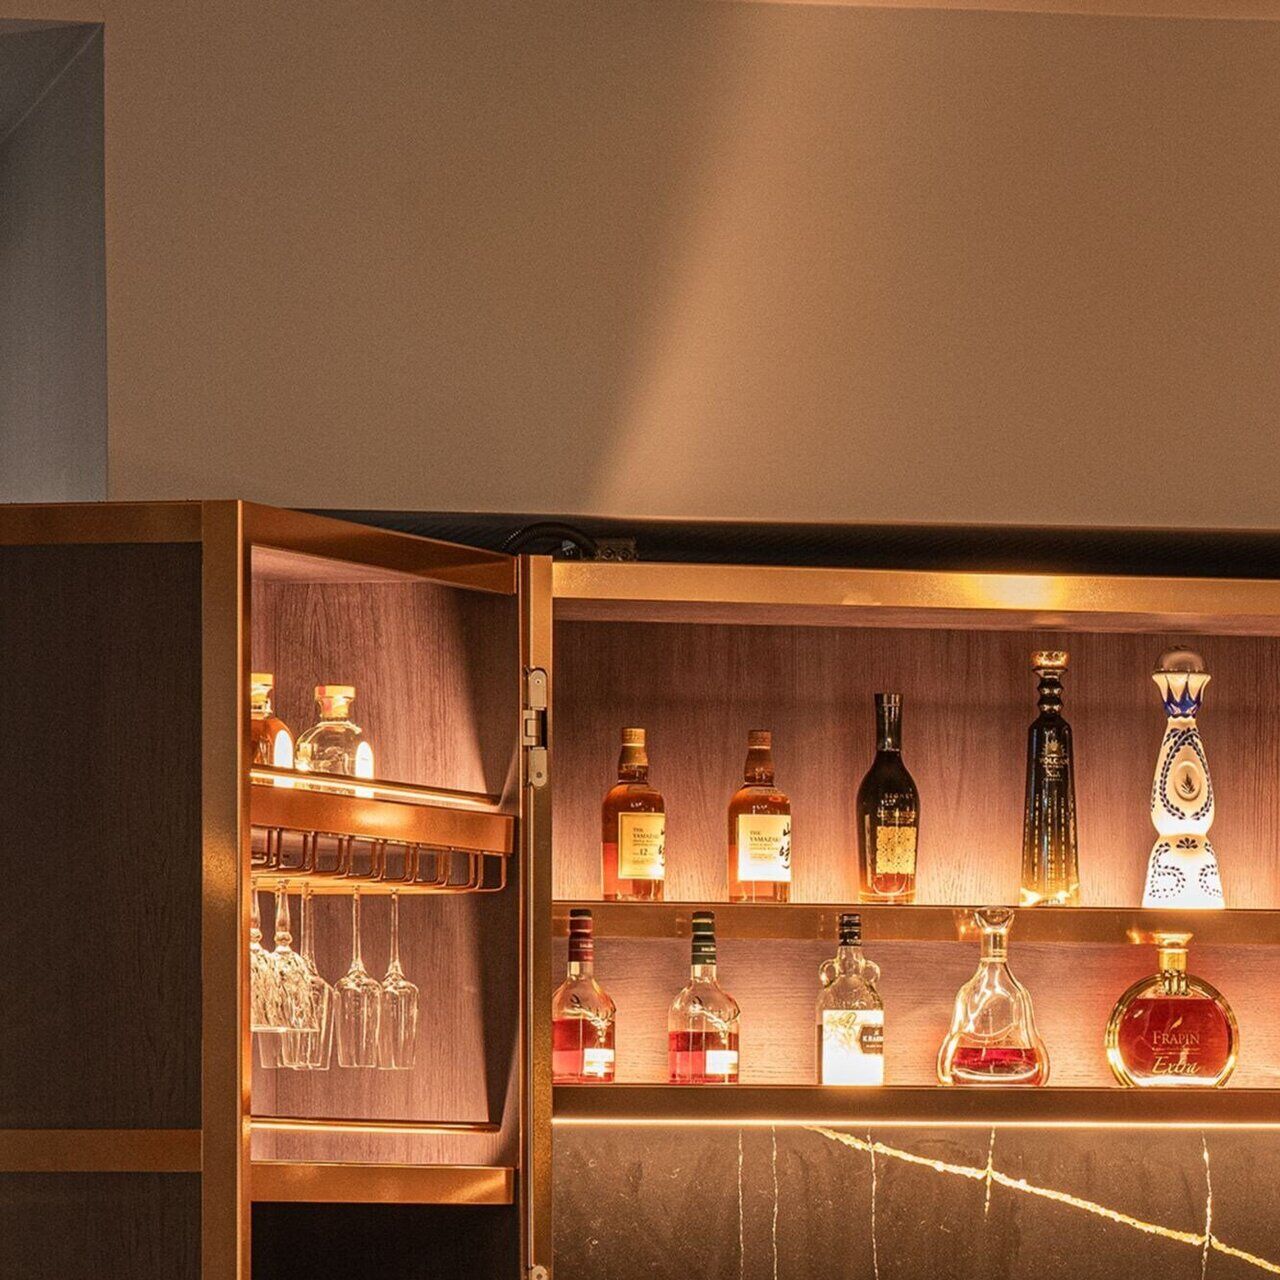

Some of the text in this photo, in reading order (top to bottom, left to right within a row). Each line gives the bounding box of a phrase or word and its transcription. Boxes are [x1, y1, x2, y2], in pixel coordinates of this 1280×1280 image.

[639, 848, 648, 856] 12
[1152, 1030, 1200, 1045] FRAPIN
[1152, 1055, 1201, 1074] Extra
